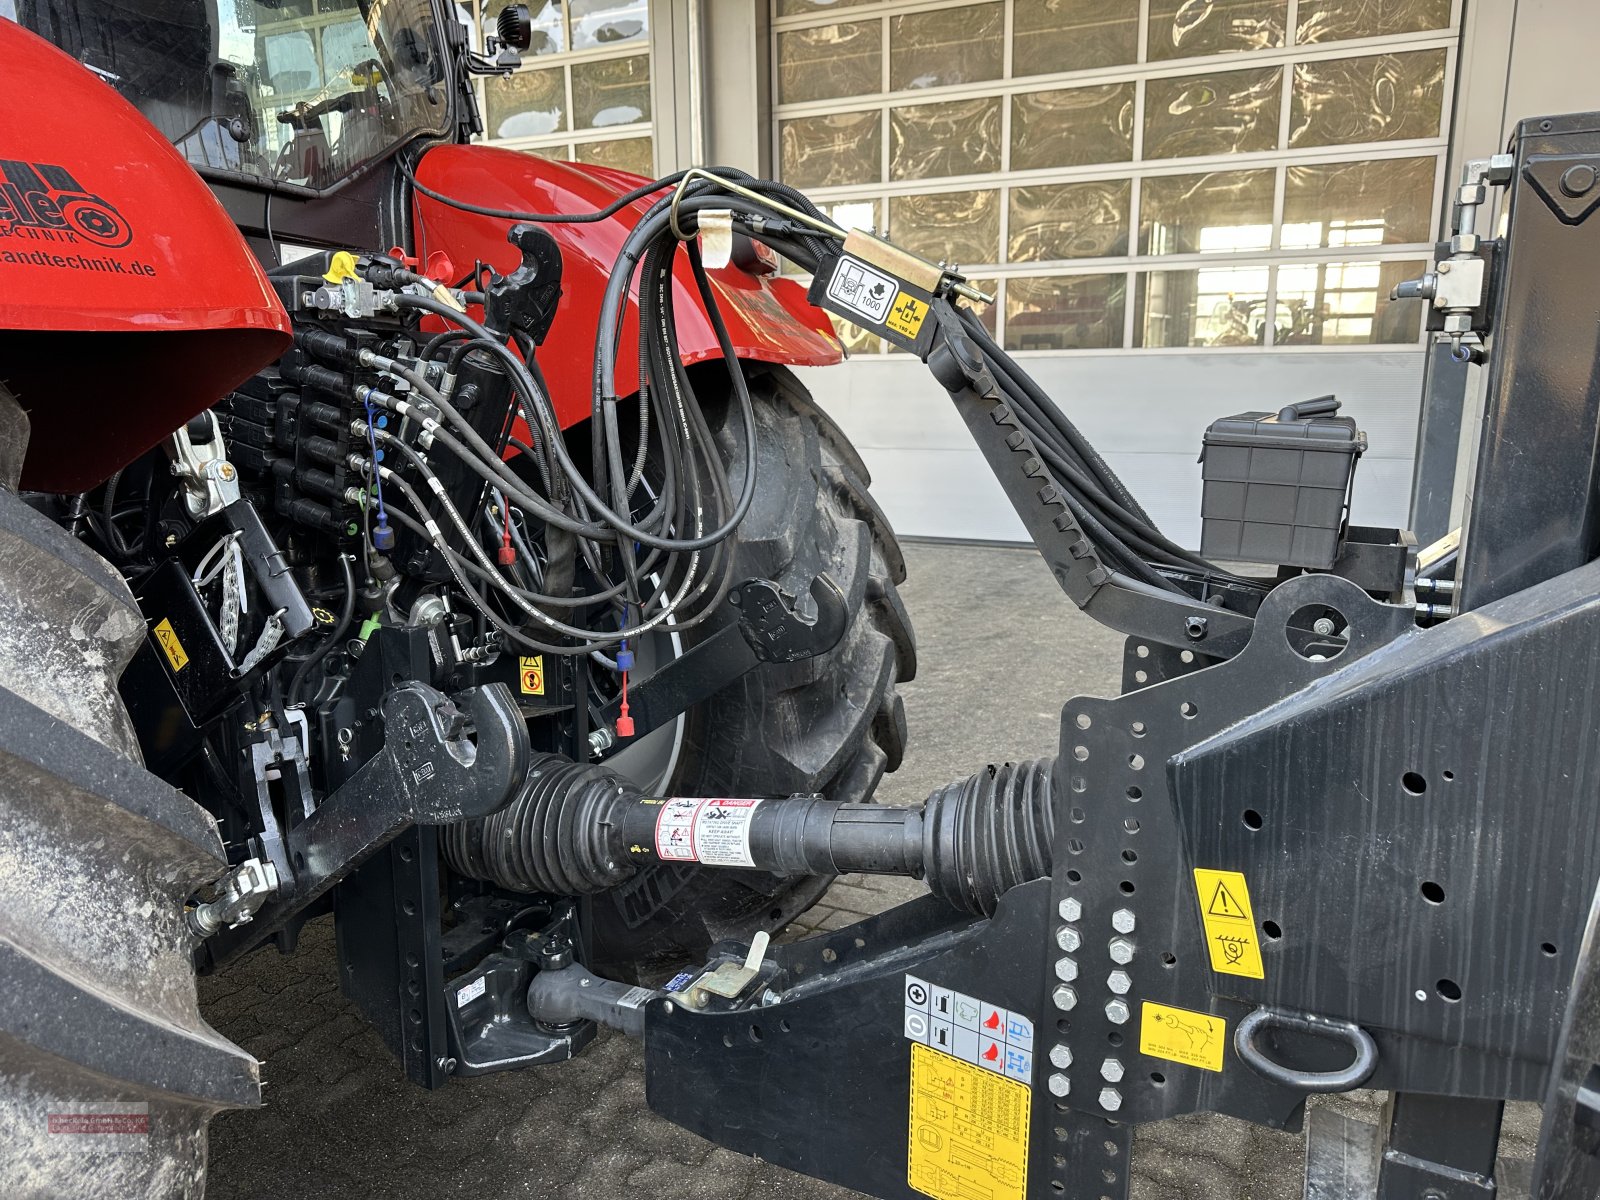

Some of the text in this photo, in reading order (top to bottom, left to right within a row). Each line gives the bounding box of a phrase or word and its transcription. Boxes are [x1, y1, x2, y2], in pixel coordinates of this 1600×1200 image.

[0, 225, 79, 245] ECHNIK
[0, 249, 157, 278] andtechnik.de
[862, 296, 881, 312] 1000
